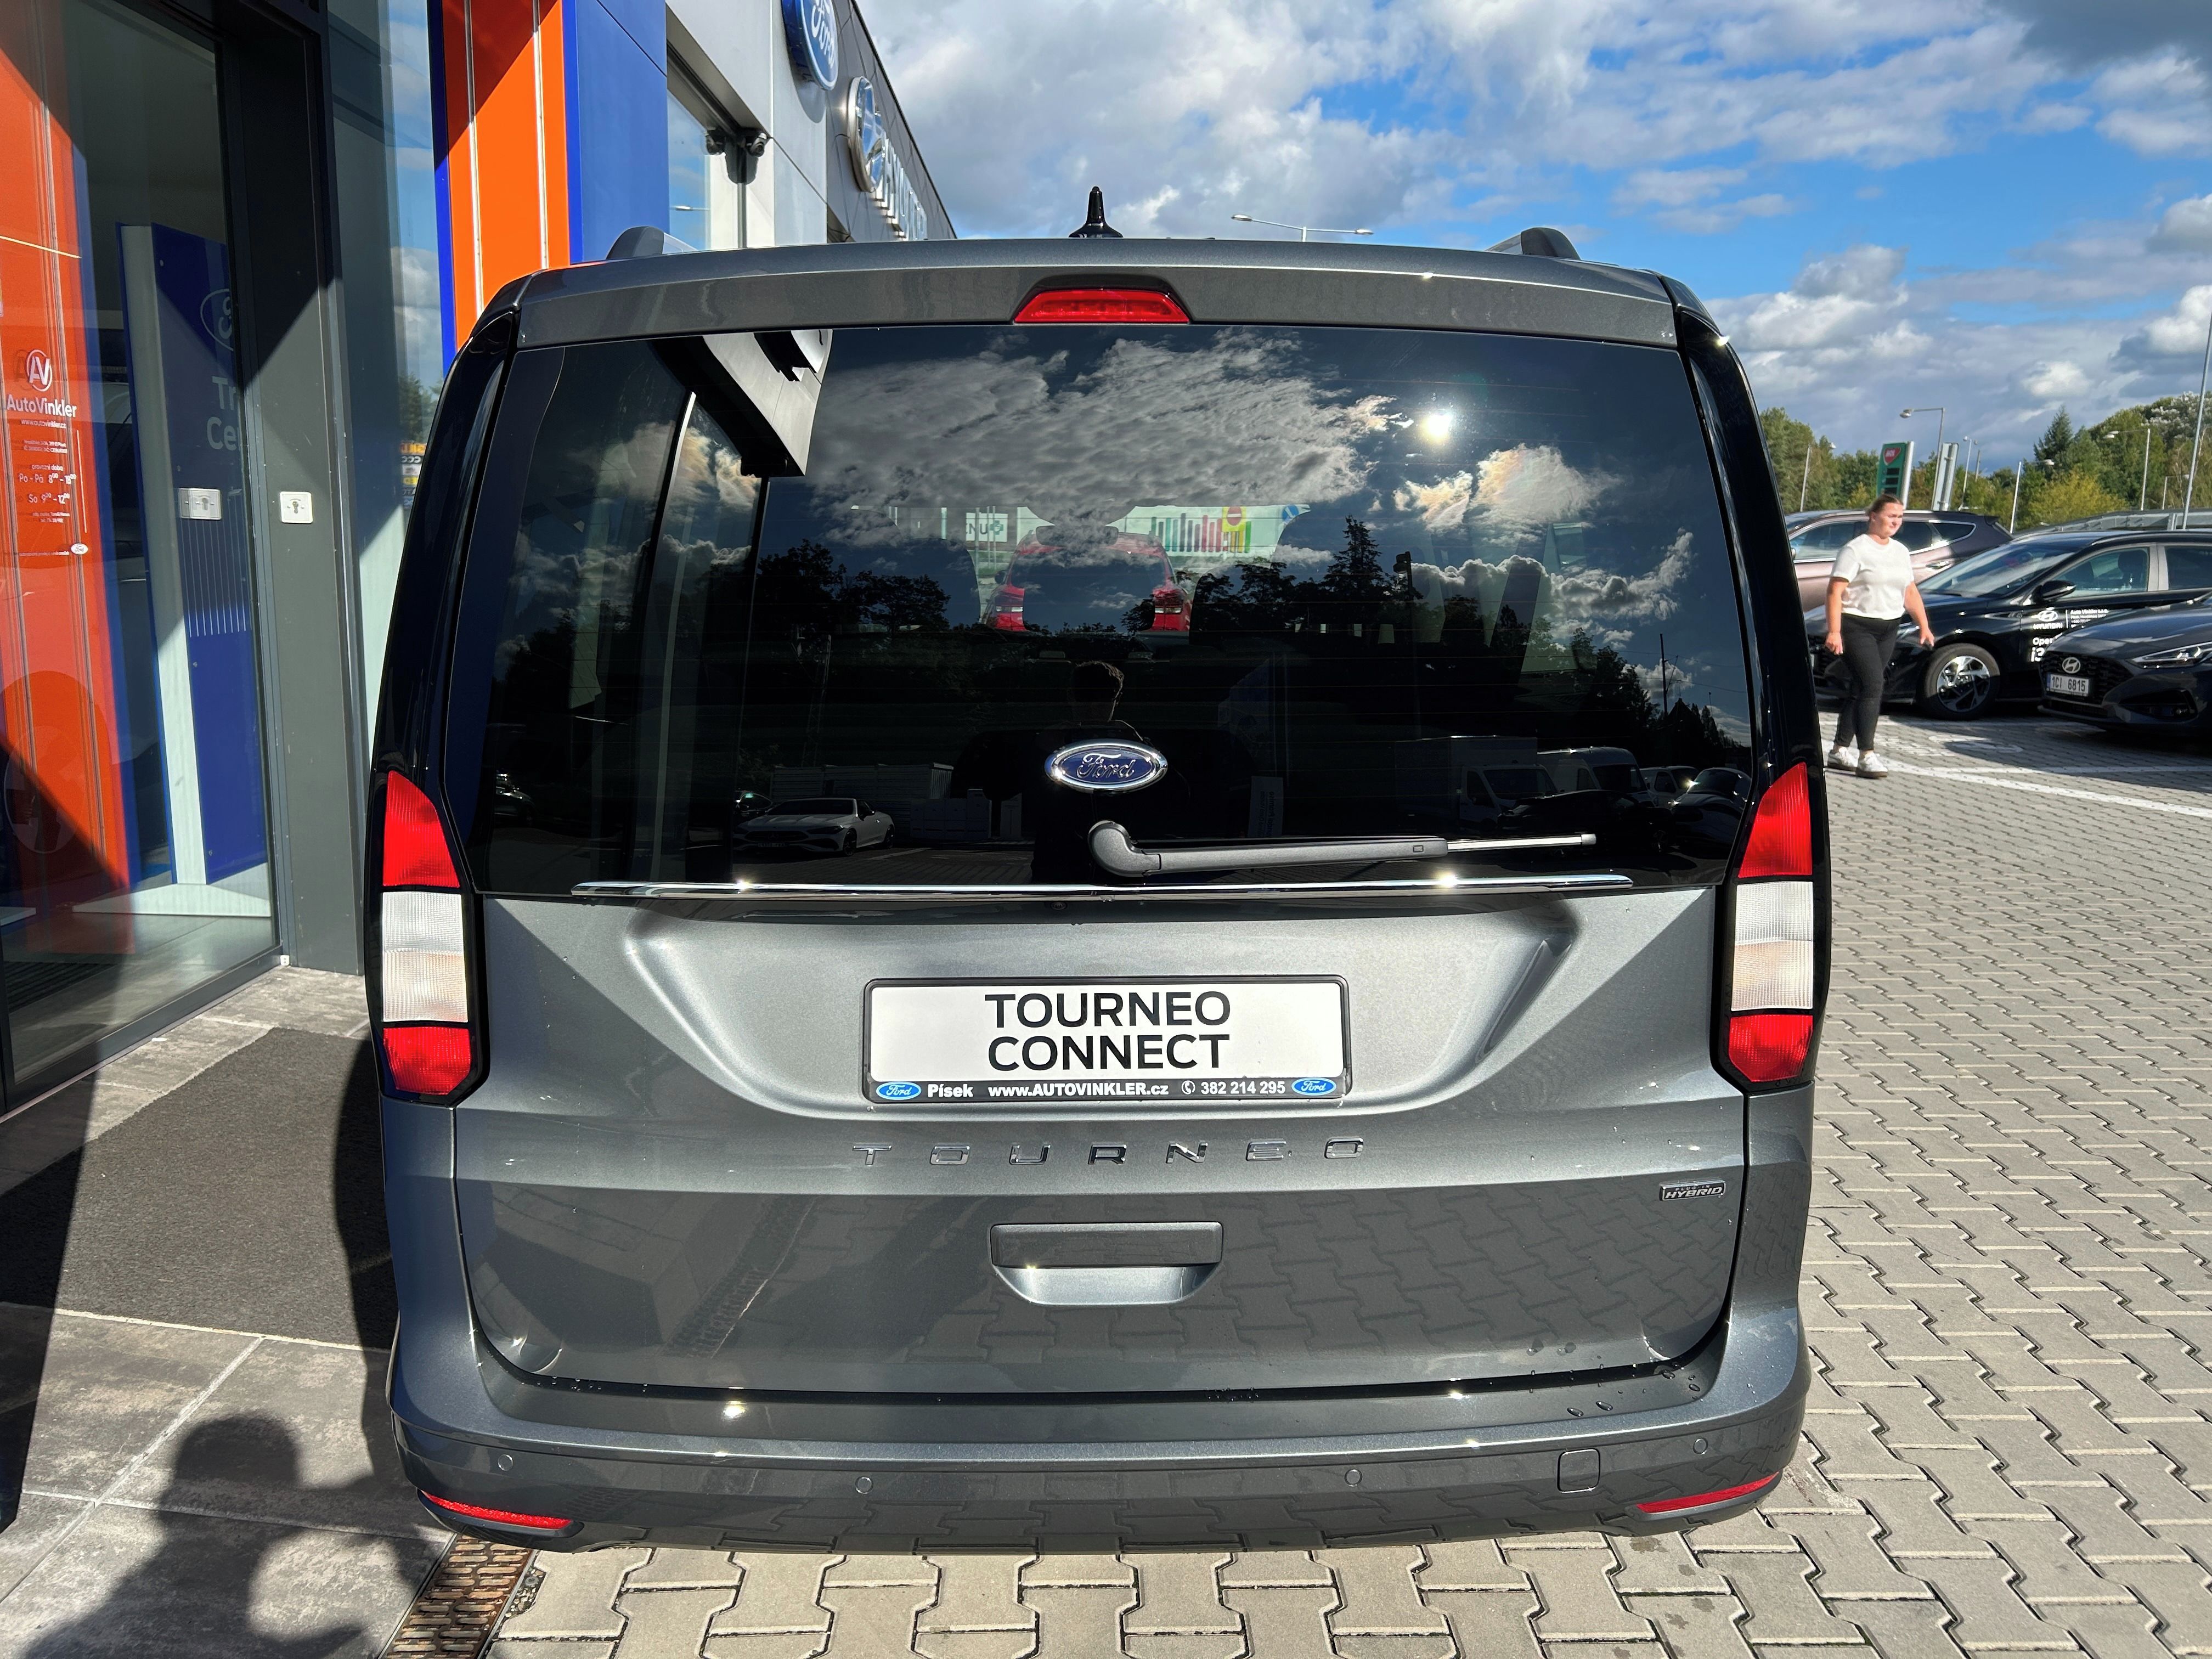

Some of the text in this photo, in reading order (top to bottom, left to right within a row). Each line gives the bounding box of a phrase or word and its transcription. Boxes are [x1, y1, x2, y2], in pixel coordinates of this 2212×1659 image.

[212, 376, 236, 410] Tr
[7, 393, 77, 417] AutoVinkler
[19, 473, 28, 483] Po
[29, 494, 38, 503] So
[2068, 678, 2086, 692] 6815
[985, 991, 1231, 1028] TOURNEO
[988, 1034, 1230, 1071] CONNECT
[928, 1081, 1285, 1098] Písek www.AUTOVINKLER.cz 382 214 295
[852, 1136, 1364, 1166] TOURNEO
[1665, 1187, 1723, 1199] HYBRID
